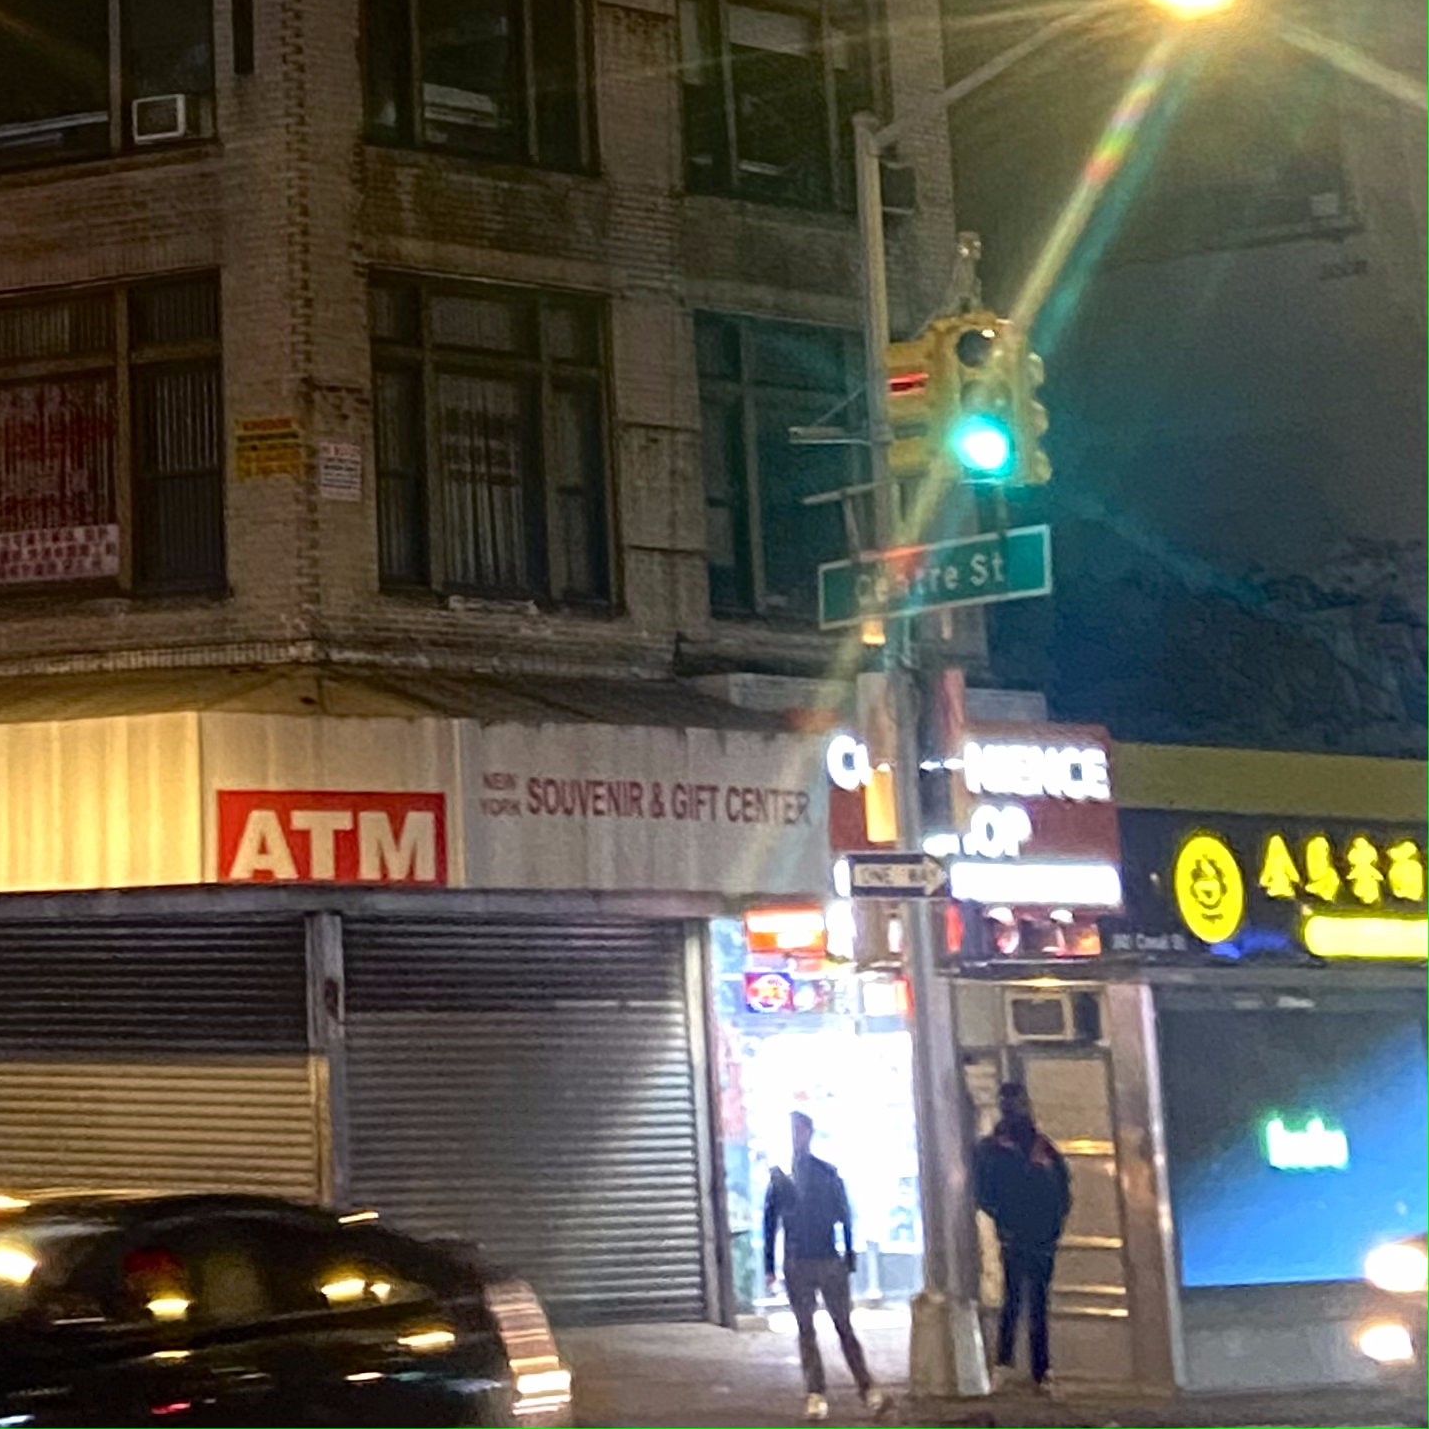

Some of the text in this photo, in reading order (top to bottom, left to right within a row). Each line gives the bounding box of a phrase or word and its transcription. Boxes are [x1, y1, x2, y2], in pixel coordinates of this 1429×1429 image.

[970, 551, 1005, 587] St
[482, 771, 517, 791] NEW
[478, 796, 522, 818] YORK
[526, 775, 812, 826] SOUVENIR & GIFT CENTER
[228, 809, 438, 882] ATM
